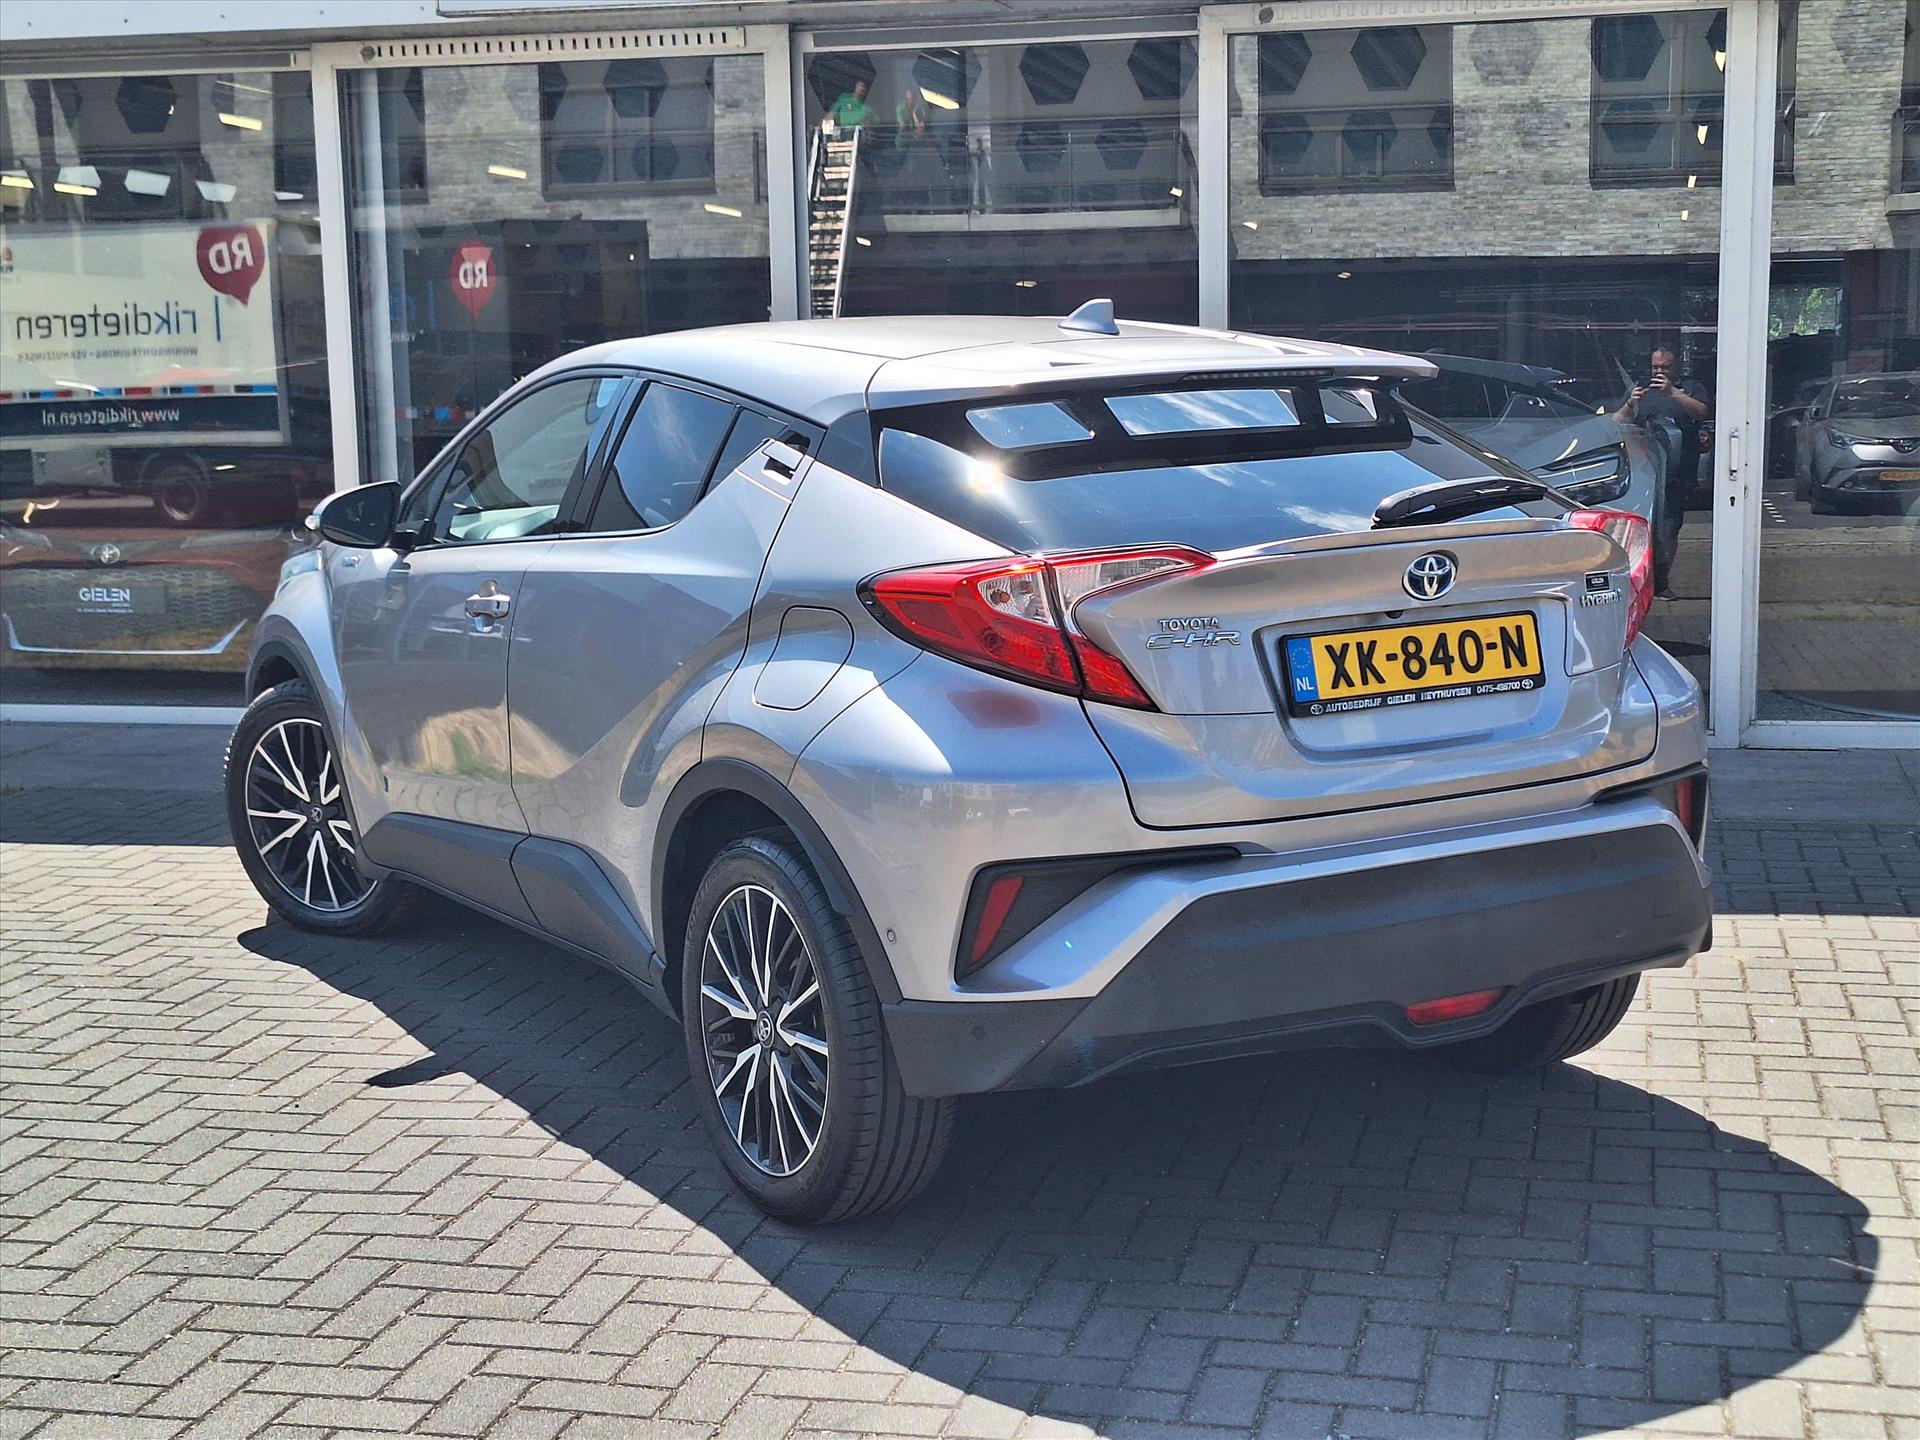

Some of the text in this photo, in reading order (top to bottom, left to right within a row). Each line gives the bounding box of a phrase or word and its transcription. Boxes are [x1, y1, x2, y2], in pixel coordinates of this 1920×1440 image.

[79, 587, 131, 601] GIELEN
[1580, 591, 1619, 608] HYBRID
[1159, 617, 1221, 632] TOYOTA
[1146, 631, 1241, 650] C-HR
[1324, 624, 1528, 690] XK-840-N
[1296, 677, 1314, 692] NL
[1325, 697, 1382, 713] AUTOBEDRIJF
[1387, 694, 1416, 705] GIELEN
